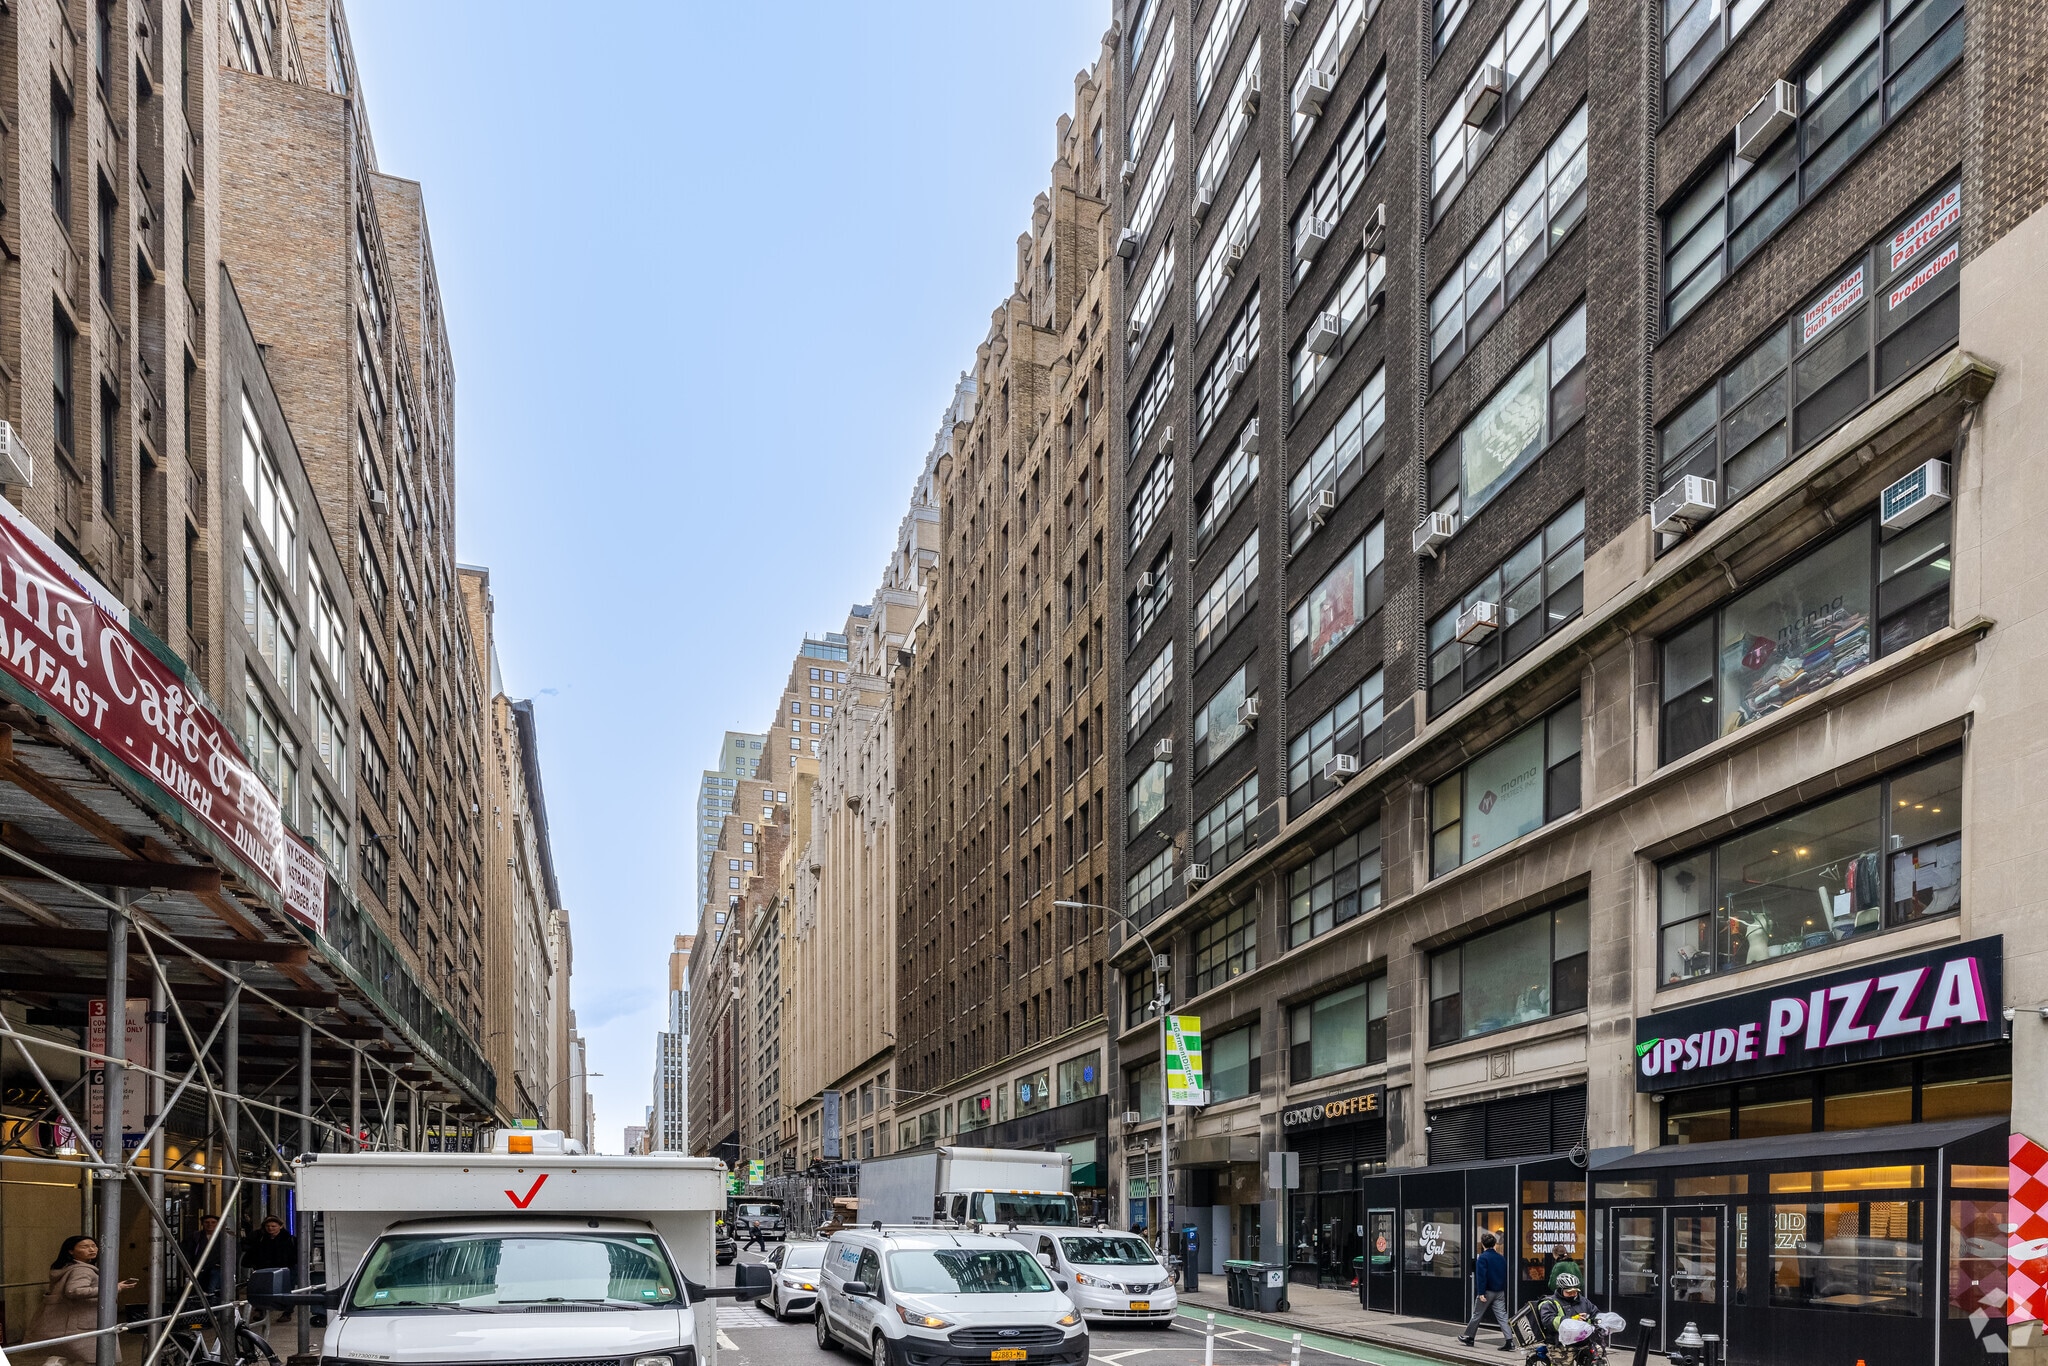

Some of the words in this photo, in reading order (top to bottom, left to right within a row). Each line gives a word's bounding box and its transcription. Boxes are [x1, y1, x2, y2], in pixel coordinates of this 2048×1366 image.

[1895, 192, 1956, 247] Sample
[1892, 207, 1959, 269] Pattern
[1891, 249, 1957, 308] Production
[1805, 271, 1861, 324] Inspection
[1805, 315, 1827, 338] Cloth
[1778, 595, 1844, 641] manna
[100, 627, 199, 763] Café
[1501, 766, 1537, 793] manna
[150, 741, 213, 817] LUNCH
[235, 820, 276, 879] DINNER
[94, 1002, 104, 1015] 3
[1641, 1022, 1759, 1077] UPSIDE
[1765, 957, 1988, 1057] PIZZA
[94, 1071, 104, 1085] 6
[1283, 1104, 1324, 1127] CORVO
[1325, 1093, 1379, 1119] COFFEE
[1169, 1147, 1180, 1161] 270
[1532, 1209, 1576, 1220] SHAWARMA
[1532, 1221, 1576, 1231] SHAWARMA
[1424, 1239, 1446, 1262] Gal
[1532, 1232, 1576, 1242] SHAWARMA
[1532, 1244, 1576, 1254] SHAWMA
